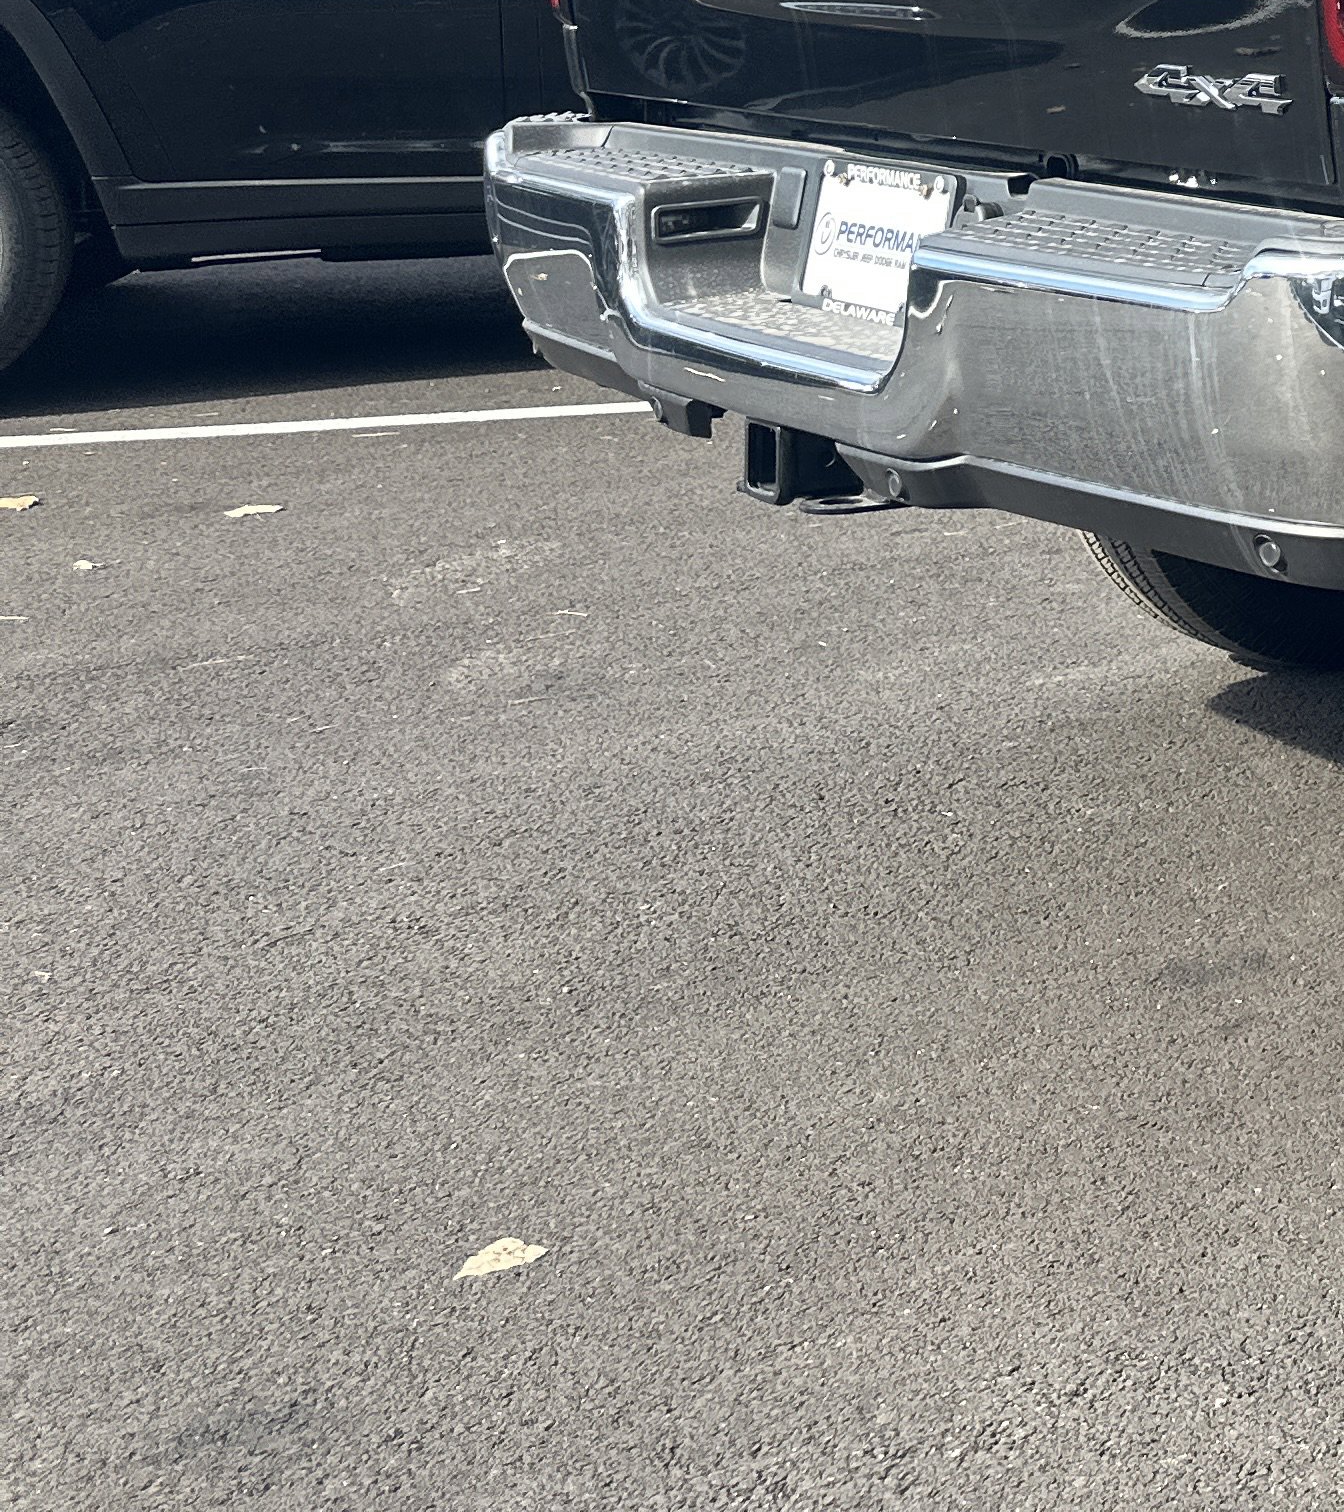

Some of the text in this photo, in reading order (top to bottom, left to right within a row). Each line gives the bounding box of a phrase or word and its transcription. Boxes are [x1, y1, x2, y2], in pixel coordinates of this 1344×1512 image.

[847, 163, 921, 191] PERFORMANCE
[836, 220, 920, 254] PERFORMA
[822, 298, 896, 326] DELAWARE
